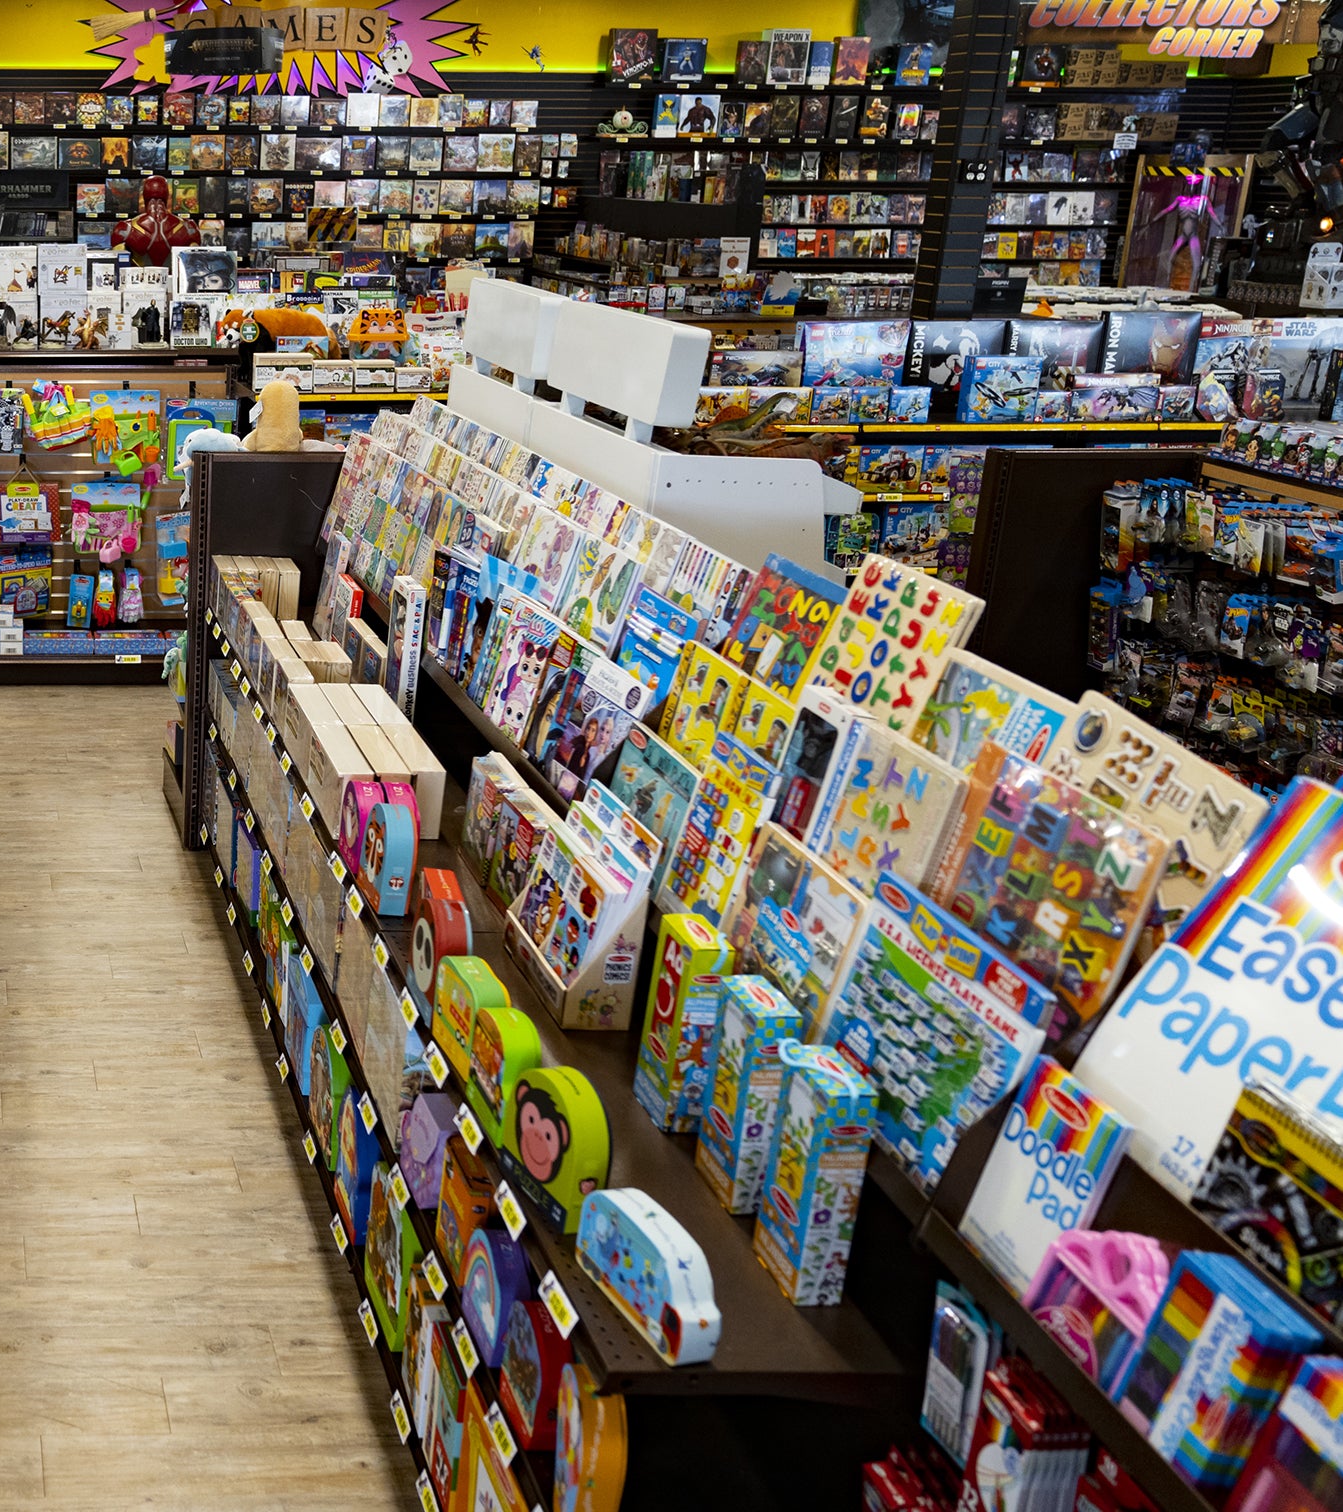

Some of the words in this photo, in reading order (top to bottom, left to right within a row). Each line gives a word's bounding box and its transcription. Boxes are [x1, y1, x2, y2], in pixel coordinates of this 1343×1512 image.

[1028, 0, 1283, 28] COLLECTORS
[773, 32, 803, 42] WEAPON
[805, 32, 810, 42] X
[1147, 27, 1264, 58] CORNER
[238, 280, 260, 290] MARVEL
[1009, 324, 1020, 349] HARRY
[1107, 316, 1123, 348] IRON
[1285, 321, 1316, 330] STAR
[1286, 328, 1318, 337] WARS
[174, 338, 194, 346] DOCTOR
[195, 338, 208, 346] WHO
[912, 325, 925, 375] MICKEY
[988, 360, 1008, 368] CITY
[5, 502, 43, 512] CREATE
[414, 597, 425, 619] PLAY
[410, 624, 421, 649] STACK
[605, 962, 632, 973] PHONICS
[877, 917, 904, 948] U.S.A.
[906, 939, 949, 984] LICENSE
[949, 974, 983, 1014] PLATE
[983, 1004, 1020, 1043] GAME
[1117, 946, 1327, 1098] Paper
[1004, 1105, 1096, 1201] Doodle
[1026, 1169, 1082, 1231] Pad
